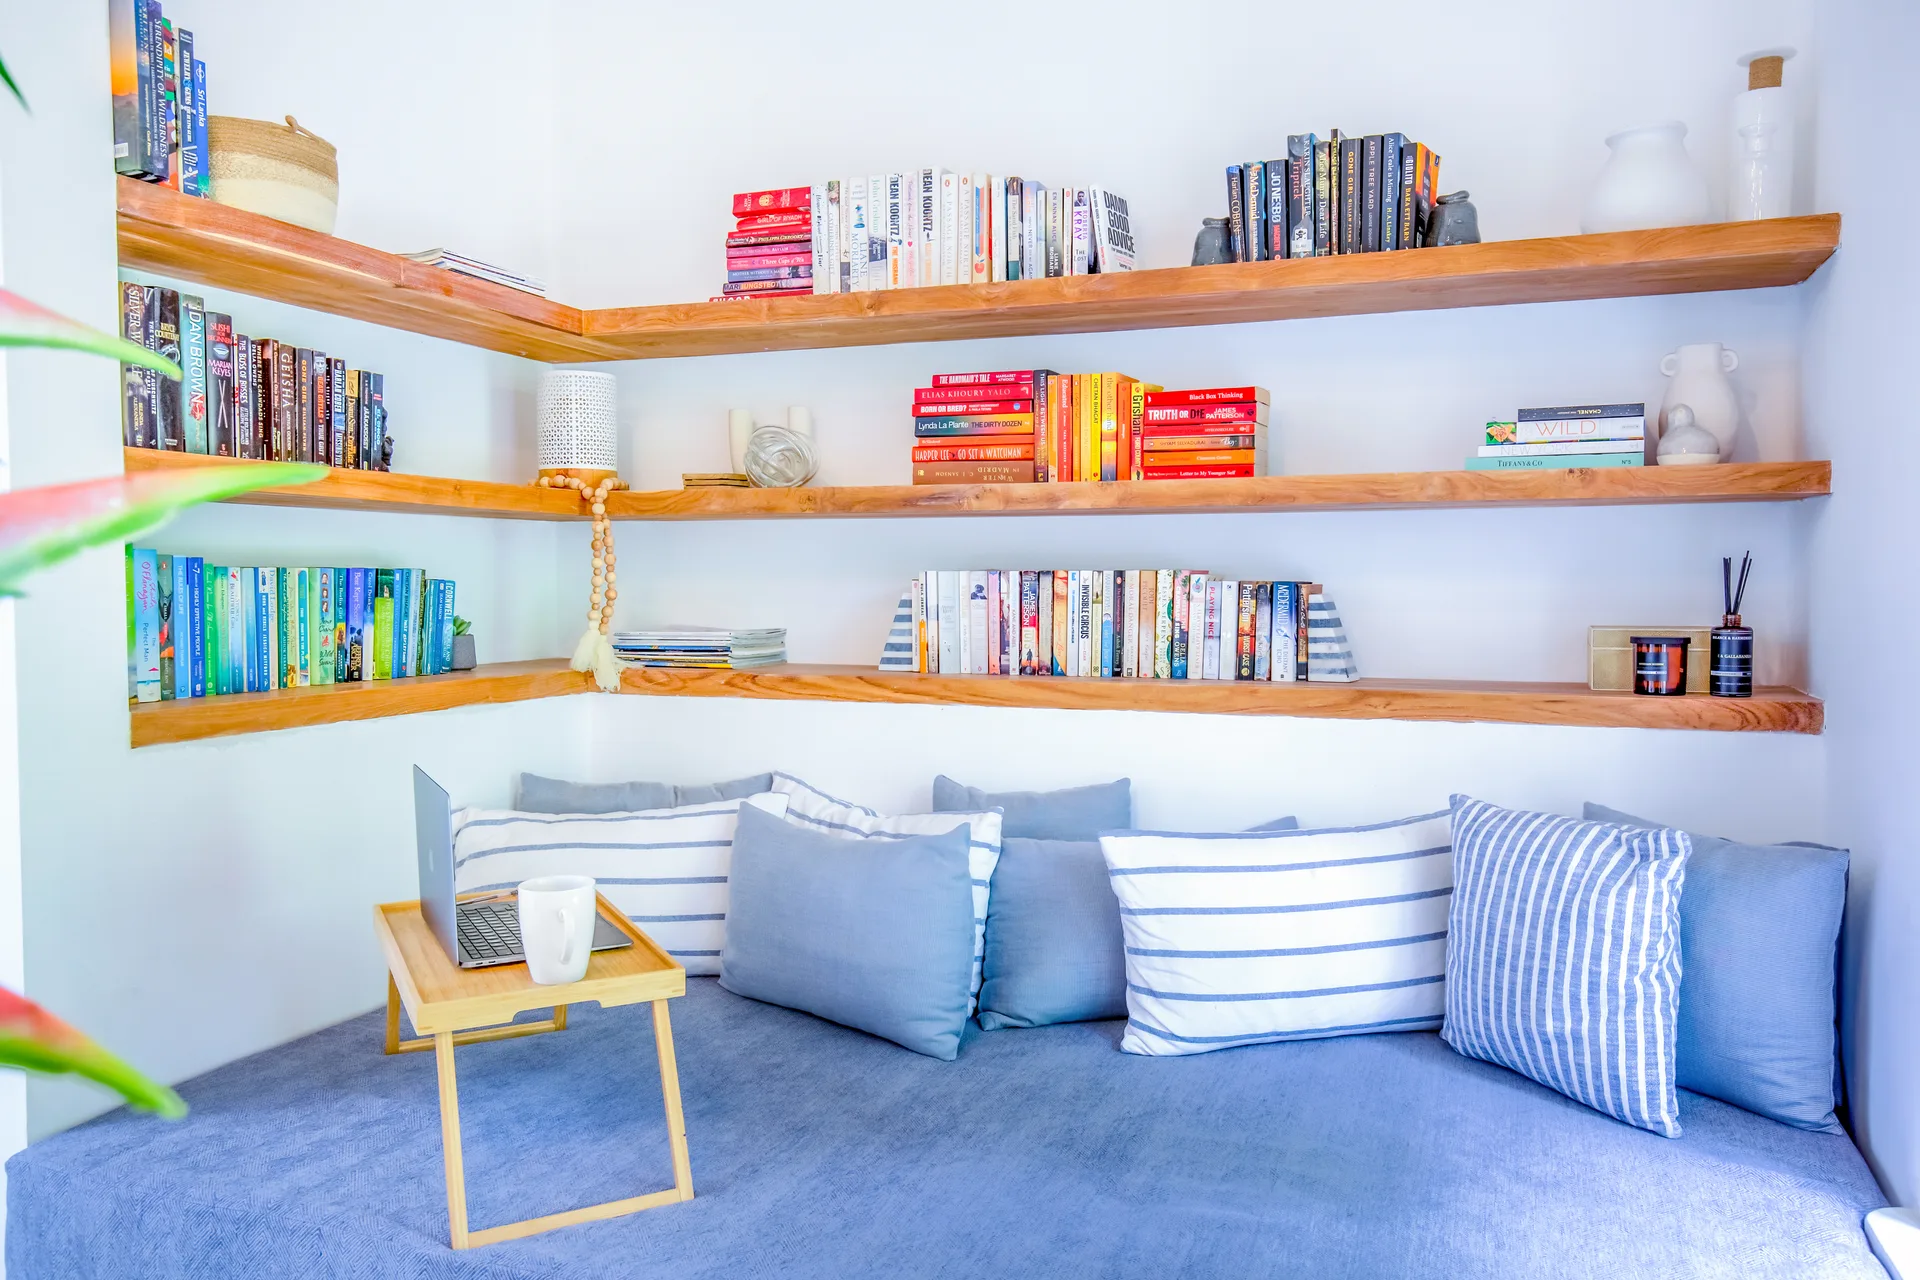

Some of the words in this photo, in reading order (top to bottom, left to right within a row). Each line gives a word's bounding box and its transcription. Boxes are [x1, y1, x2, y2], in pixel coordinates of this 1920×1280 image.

[154, 19, 164, 80] SERENDIPITY
[157, 83, 165, 96] OF
[197, 88, 206, 99] Sri
[198, 101, 206, 127] Lanka
[158, 99, 168, 158] WILDERNESS
[1303, 139, 1312, 166] KARIN
[1368, 140, 1376, 166] APPLE
[1386, 137, 1395, 154] Alice
[1347, 151, 1355, 174] GONE
[889, 177, 899, 200] DEAN
[923, 168, 933, 193] DEAN
[1231, 177, 1239, 199] Harlan
[1271, 172, 1281, 186] JO
[1319, 173, 1328, 199] Munro
[1368, 167, 1376, 187] TREE
[1303, 167, 1312, 217] SLAUGHTER
[1385, 178, 1394, 203] Missing
[923, 196, 933, 232] KOONTZ
[1103, 190, 1129, 217] DAMN
[1271, 187, 1282, 223] NESBØ
[1319, 201, 1328, 220] Dear
[889, 203, 900, 236] KOONTZ
[1073, 210, 1082, 241] KRAY
[1107, 209, 1130, 234] GOOD
[1231, 200, 1241, 232] COBEN
[1107, 227, 1136, 254] ADVICE
[1319, 222, 1327, 239] Life
[1403, 222, 1411, 241] BARN
[762, 257, 777, 265] Three
[778, 256, 791, 266] Cups
[852, 232, 860, 287] MORIARTY
[860, 242, 868, 278] LIANE
[129, 289, 142, 328] SILVER
[189, 311, 202, 344] DAN
[209, 322, 231, 334] SUSHI
[208, 358, 232, 370] MARIAN
[211, 367, 232, 377] KEYES
[238, 353, 248, 370] BOSS
[190, 345, 204, 404] BROWN
[239, 370, 247, 379] OF
[281, 352, 292, 408] GEISHA
[939, 375, 948, 385] THE
[979, 373, 991, 382] TALE
[239, 380, 249, 404] BOSSES
[921, 391, 945, 399] ELIAS
[947, 390, 985, 398] KHOURY
[987, 388, 1011, 396] YALO
[1061, 379, 1070, 409] Educated
[1189, 393, 1205, 401] Black
[920, 405, 938, 414] BORN
[946, 404, 967, 412] BRED?
[1132, 394, 1144, 437] Grisham
[1147, 409, 1178, 420] TRUTH
[1178, 410, 1189, 419] OR
[918, 421, 938, 431] Lynda
[938, 421, 948, 429] La
[948, 420, 969, 429] Plante
[984, 420, 1002, 428] DIRTY
[1535, 419, 1597, 436] WILD
[1040, 437, 1047, 446] US
[915, 450, 939, 461] HARPER
[940, 450, 950, 460] LEE
[957, 449, 966, 459] GO
[968, 448, 978, 459] SET
[985, 447, 1022, 459] WATCHMAN
[268, 569, 276, 595] David
[178, 594, 184, 603] OF
[267, 597, 276, 623] Lodge
[443, 585, 455, 621] CORNWELL
[1081, 584, 1090, 614] INVISIBLE
[1208, 586, 1216, 619] PLAYING
[1241, 583, 1254, 622] Patterson
[142, 622, 150, 646] Perfect
[1080, 614, 1089, 639] CIRCUS
[350, 641, 358, 671] ARCHER
[1179, 642, 1187, 664] DELIA
[1242, 635, 1250, 653] WORST
[355, 645, 363, 669] JEFFREY
[1242, 653, 1250, 667] CASE
